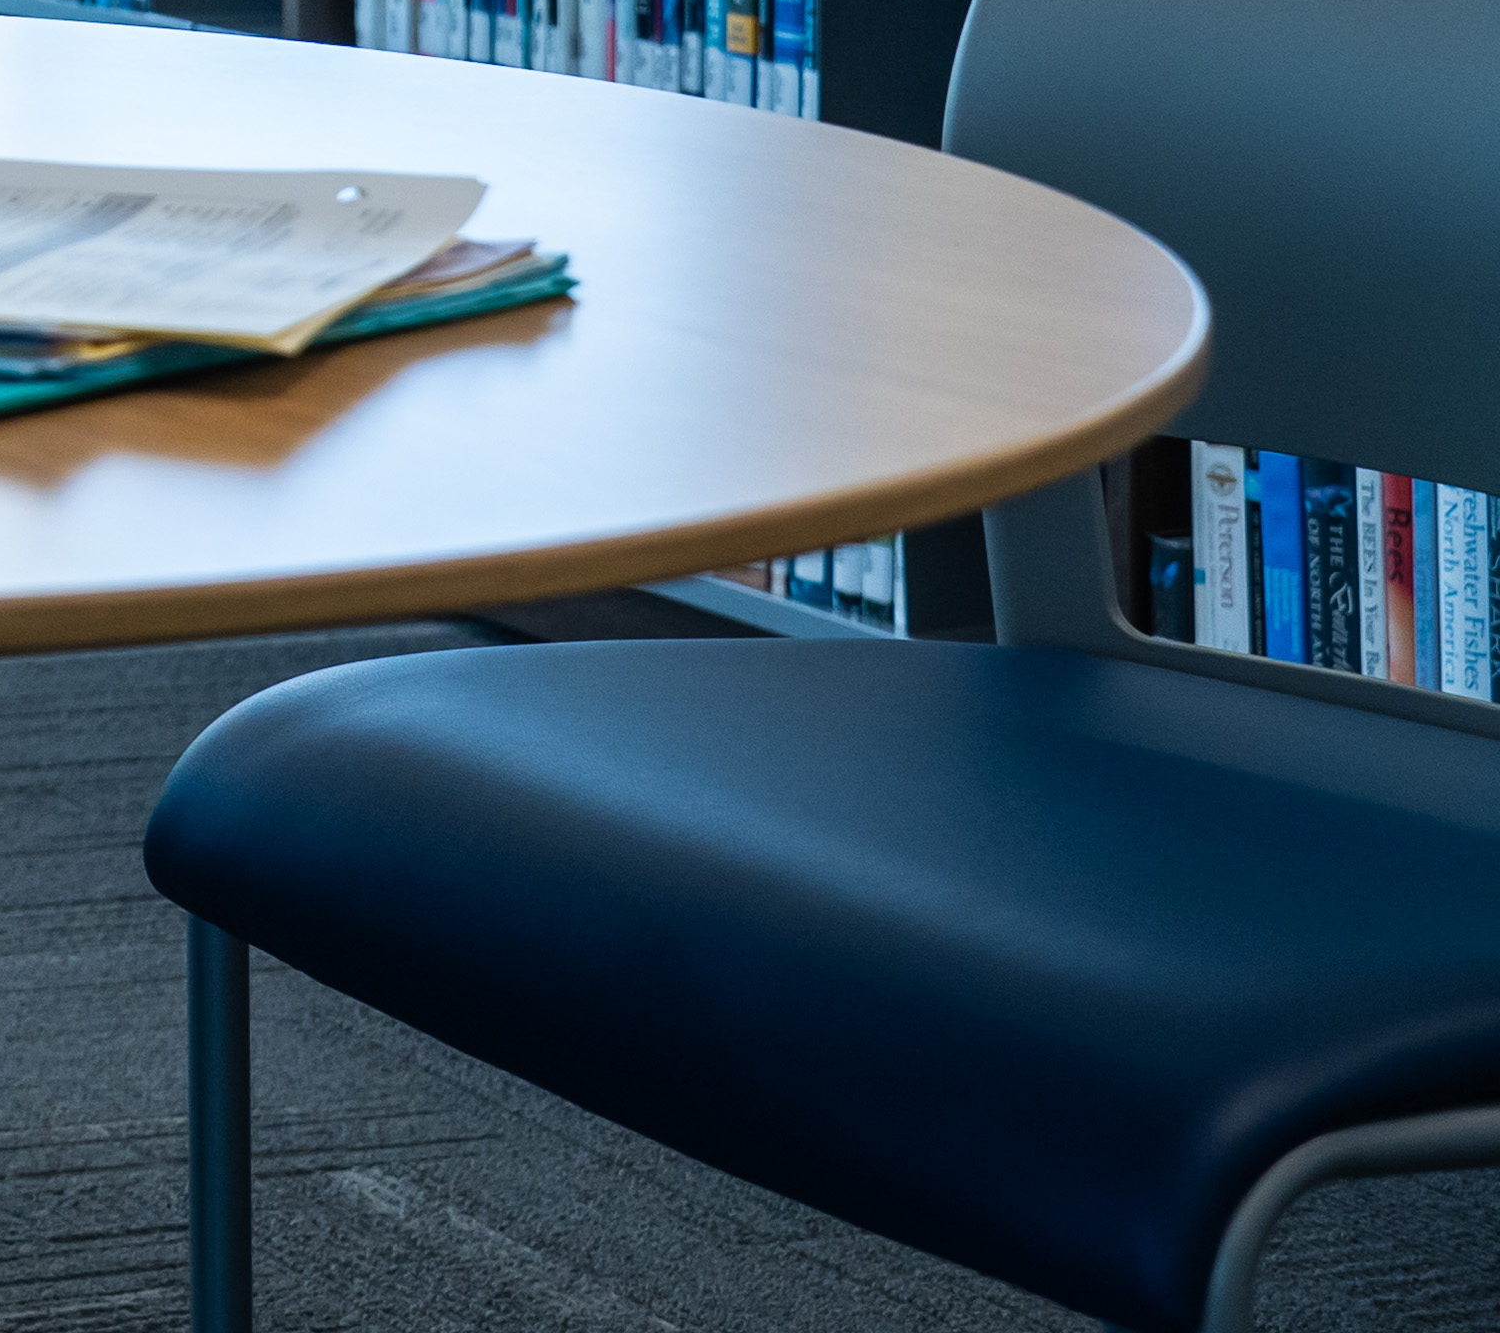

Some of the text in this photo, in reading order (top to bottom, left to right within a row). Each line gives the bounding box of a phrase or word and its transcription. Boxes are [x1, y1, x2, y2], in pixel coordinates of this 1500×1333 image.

[1217, 504, 1239, 609] Peterson
[1329, 525, 1344, 567] THE
[1362, 521, 1377, 573] BEES
[1386, 507, 1411, 582] Bees
[1443, 499, 1459, 573] North
[1308, 552, 1322, 632] NORTH
[1462, 488, 1488, 691] reshwater Fishes
[1443, 583, 1459, 686] America
